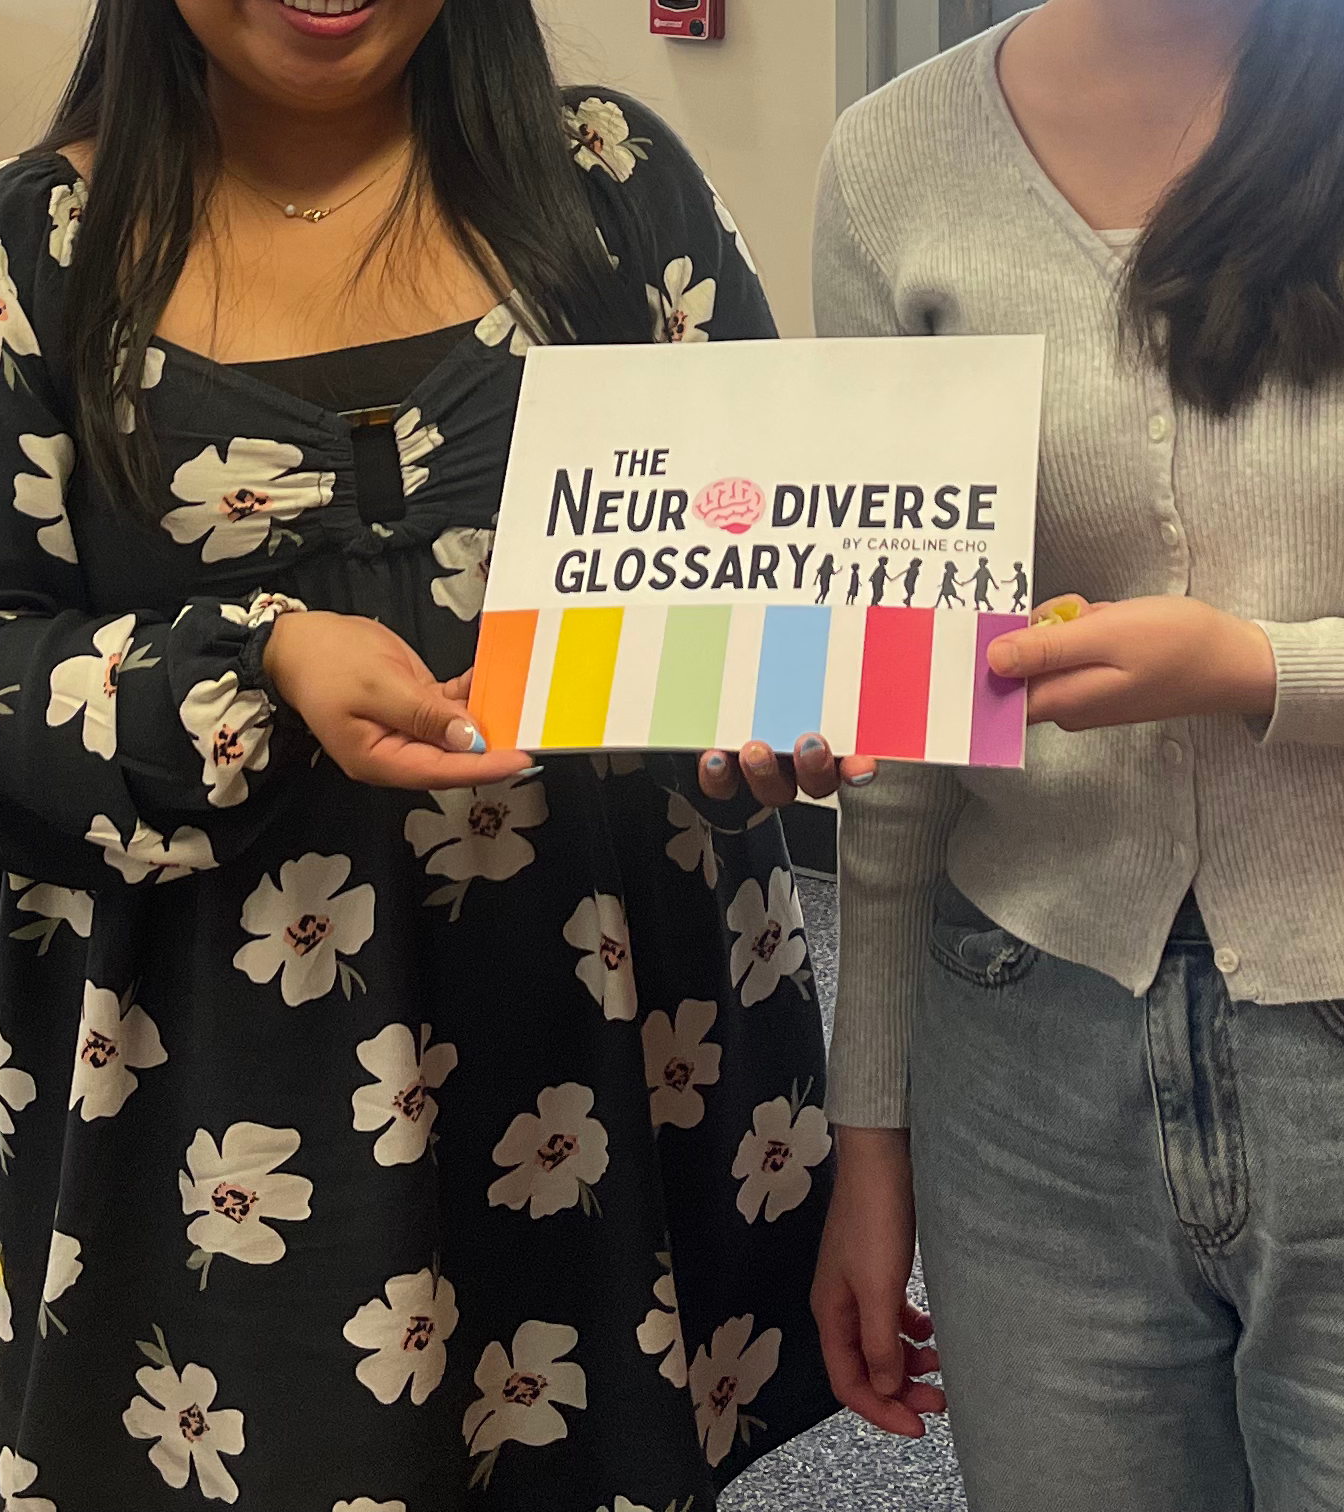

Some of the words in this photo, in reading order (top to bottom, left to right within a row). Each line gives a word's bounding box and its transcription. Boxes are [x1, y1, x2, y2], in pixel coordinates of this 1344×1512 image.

[613, 448, 670, 477] THE
[771, 483, 998, 532] DIVERSE
[842, 538, 862, 551] BY
[866, 537, 948, 552] CAROLINE
[953, 539, 988, 553] CHO
[555, 543, 816, 595] GLOSSARY
